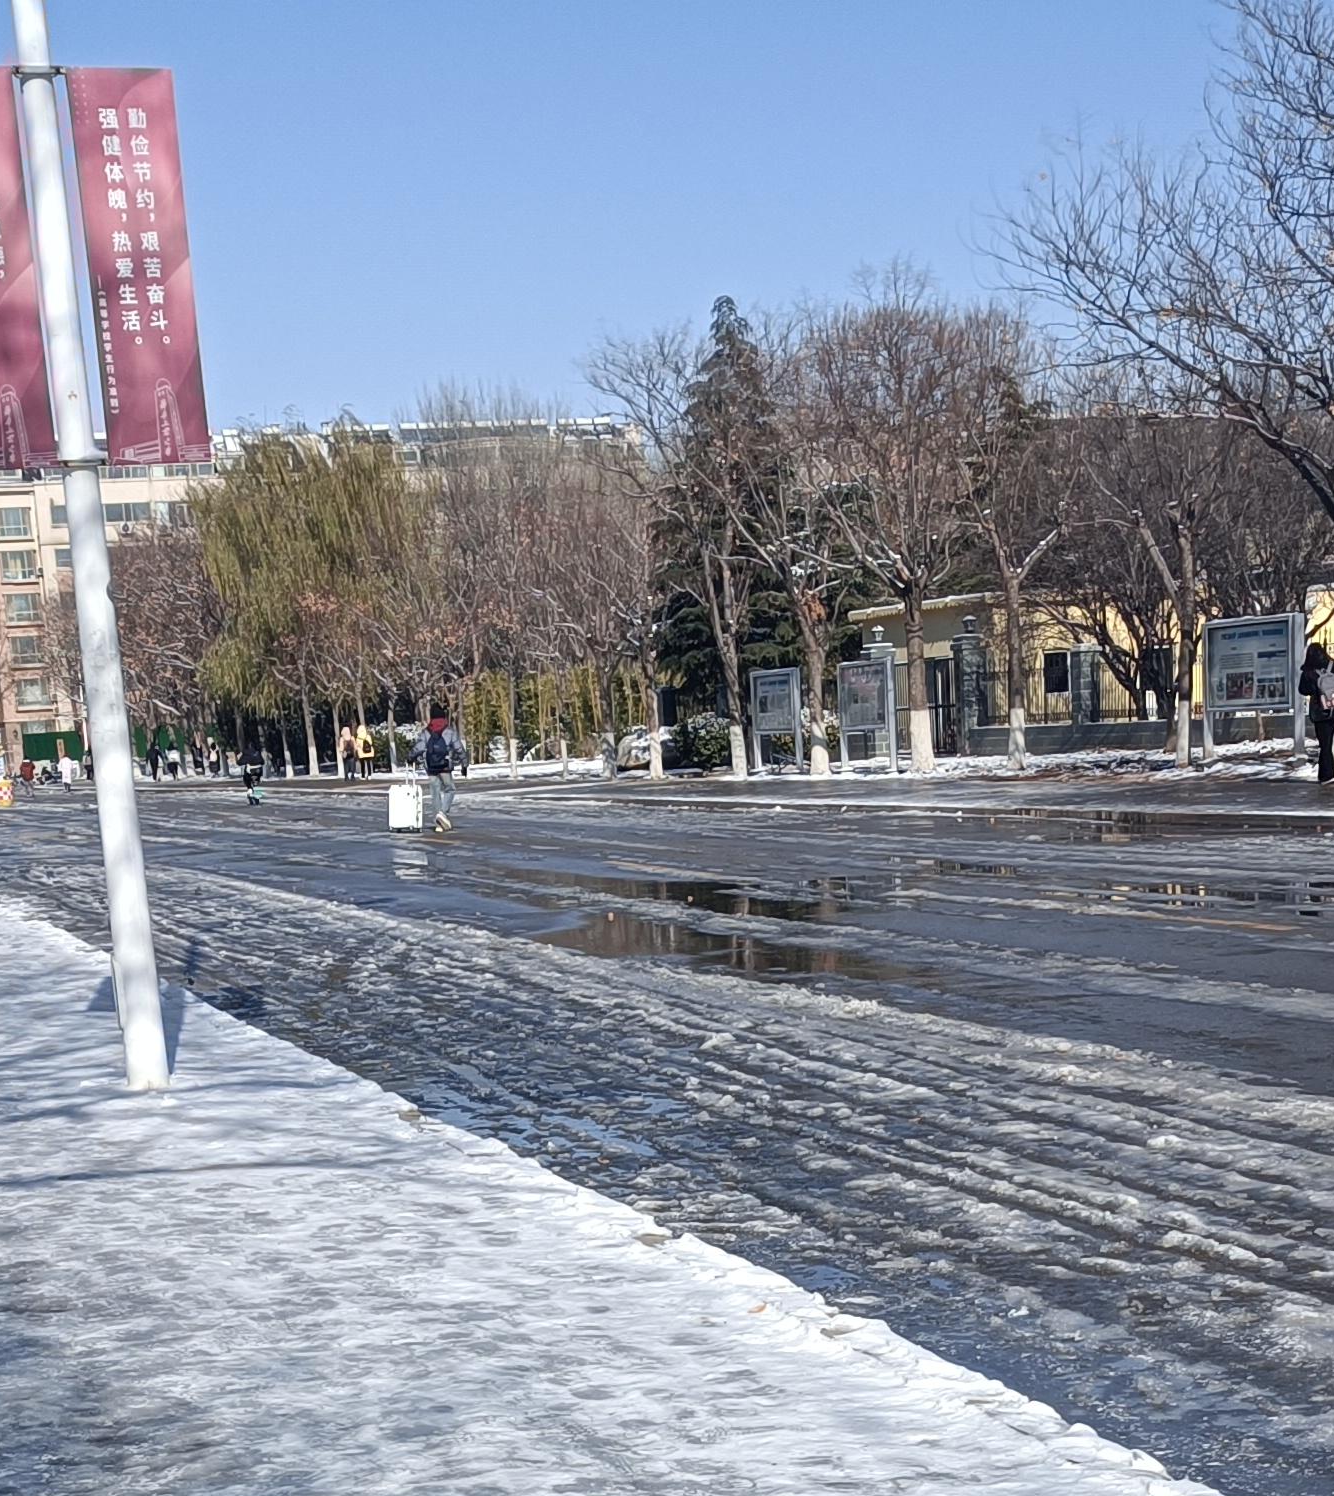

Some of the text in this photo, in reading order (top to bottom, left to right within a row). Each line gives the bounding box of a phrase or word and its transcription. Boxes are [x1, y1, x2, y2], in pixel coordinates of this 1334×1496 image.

[98, 107, 143, 345] 强健体魄，热爱生活。
[127, 107, 170, 345] 勤俭节约，艰苦奋斗。
